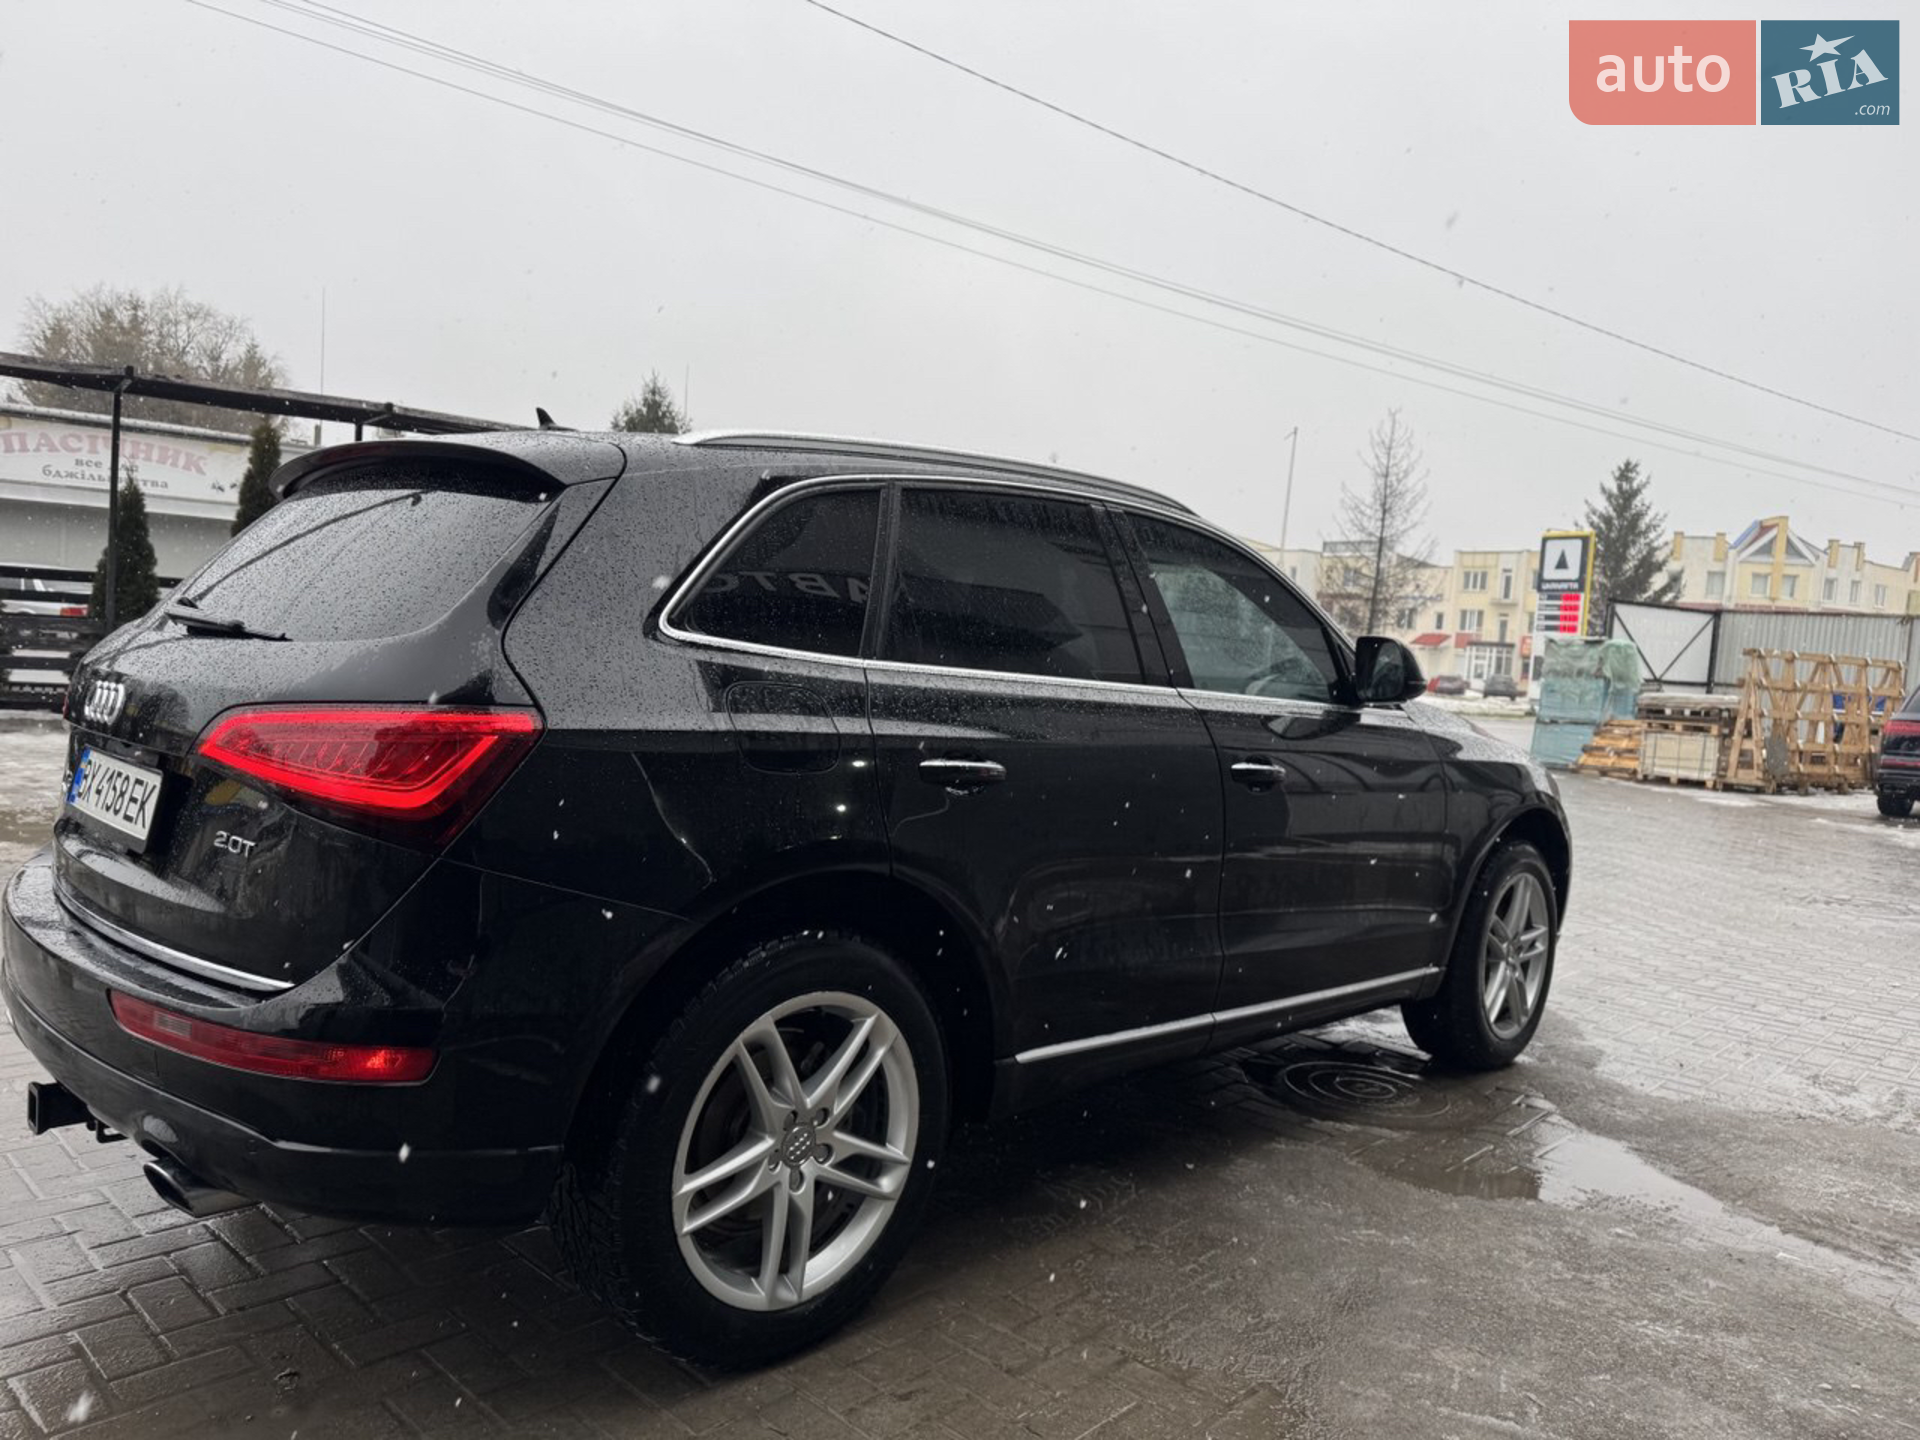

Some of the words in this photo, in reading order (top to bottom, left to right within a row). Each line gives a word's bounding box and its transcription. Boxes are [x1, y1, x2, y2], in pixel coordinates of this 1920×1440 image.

[74, 458, 103, 469] все
[42, 464, 169, 489] бджільтва
[95, 767, 130, 816] 4158
[123, 778, 157, 829] EK
